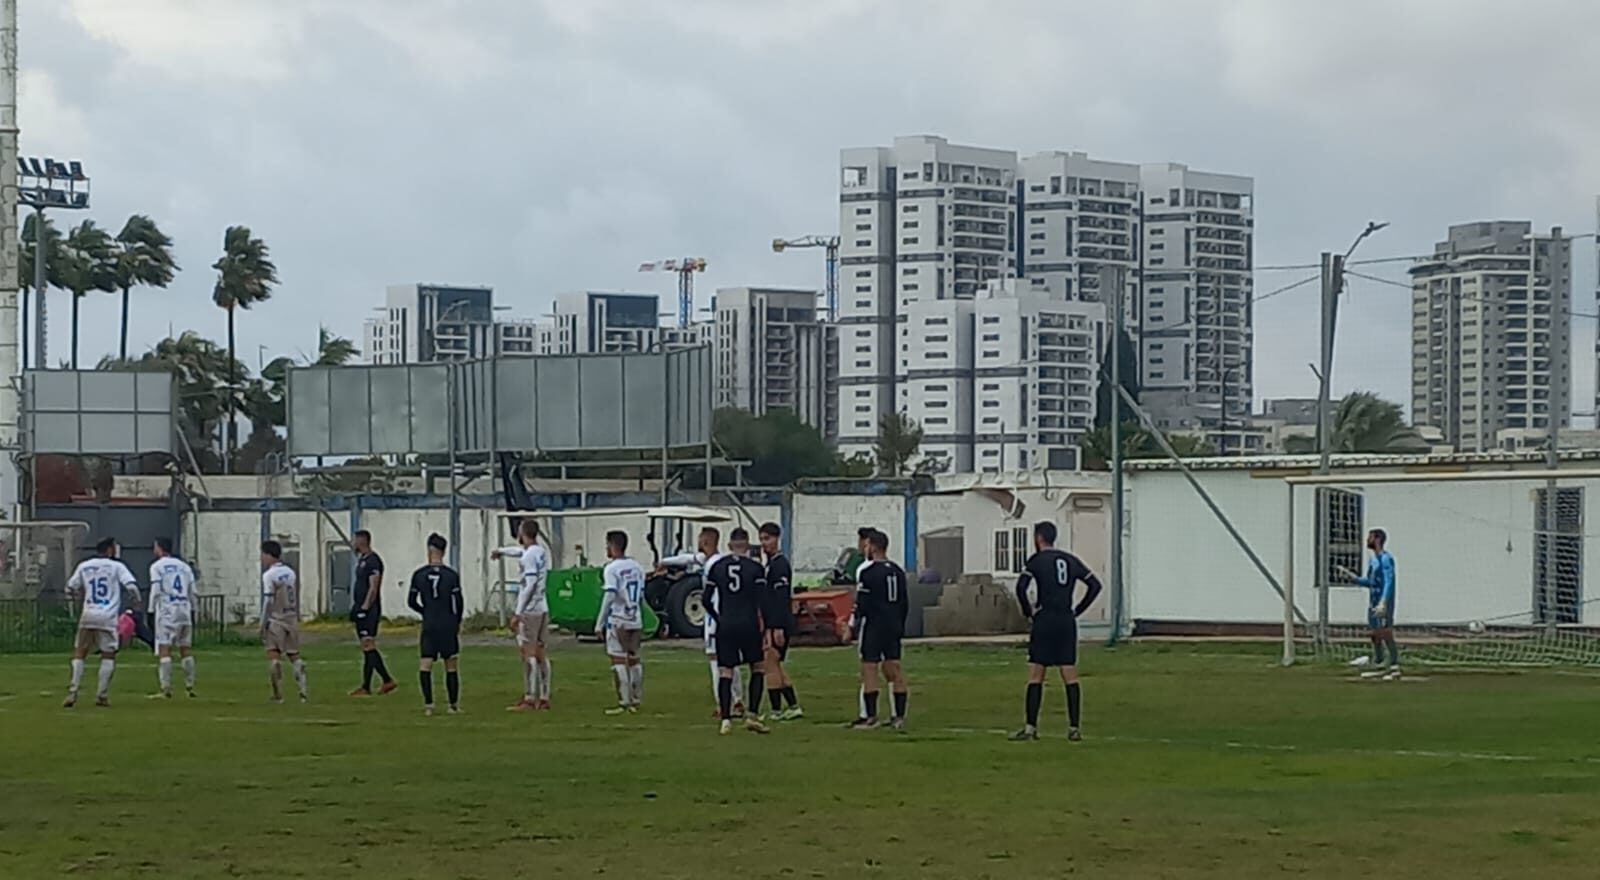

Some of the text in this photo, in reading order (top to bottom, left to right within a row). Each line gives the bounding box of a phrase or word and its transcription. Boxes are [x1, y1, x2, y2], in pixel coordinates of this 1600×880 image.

[728, 564, 741, 592] 5
[1056, 558, 1068, 585] 8
[88, 576, 108, 599] 15
[173, 574, 183, 594] 4
[428, 574, 440, 598] 7
[626, 580, 639, 602] 17
[887, 574, 898, 602] 11
